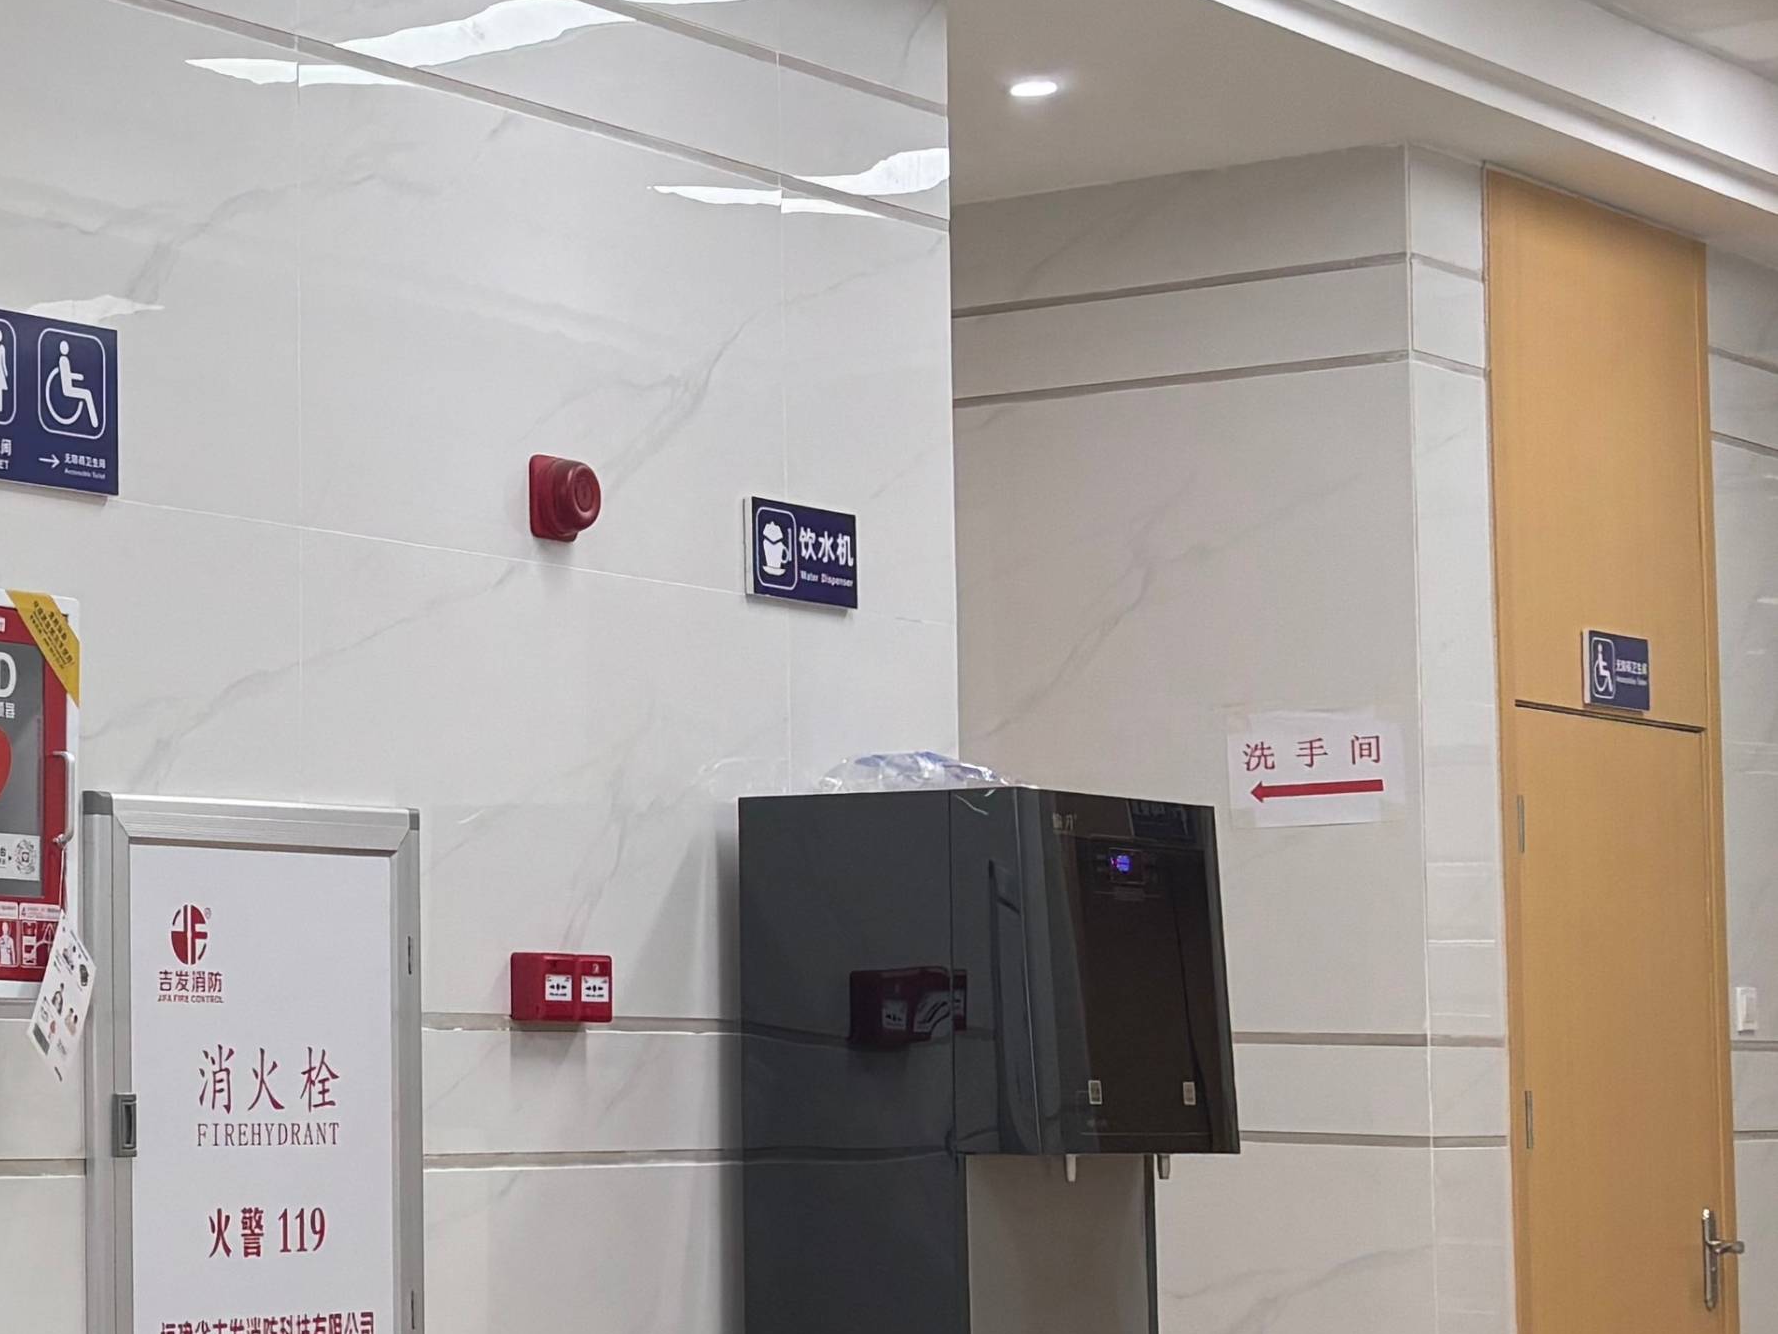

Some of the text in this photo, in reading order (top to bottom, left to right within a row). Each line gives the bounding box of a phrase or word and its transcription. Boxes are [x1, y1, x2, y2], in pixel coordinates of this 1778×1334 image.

[799, 526, 854, 567] 饮水机
[1242, 733, 1383, 772] 洗手间
[158, 969, 223, 993] 吉发消防
[198, 1044, 340, 1115] 消火栓
[197, 1122, 340, 1147] FIREHYDRANT
[208, 1207, 327, 1259] 火警 119
